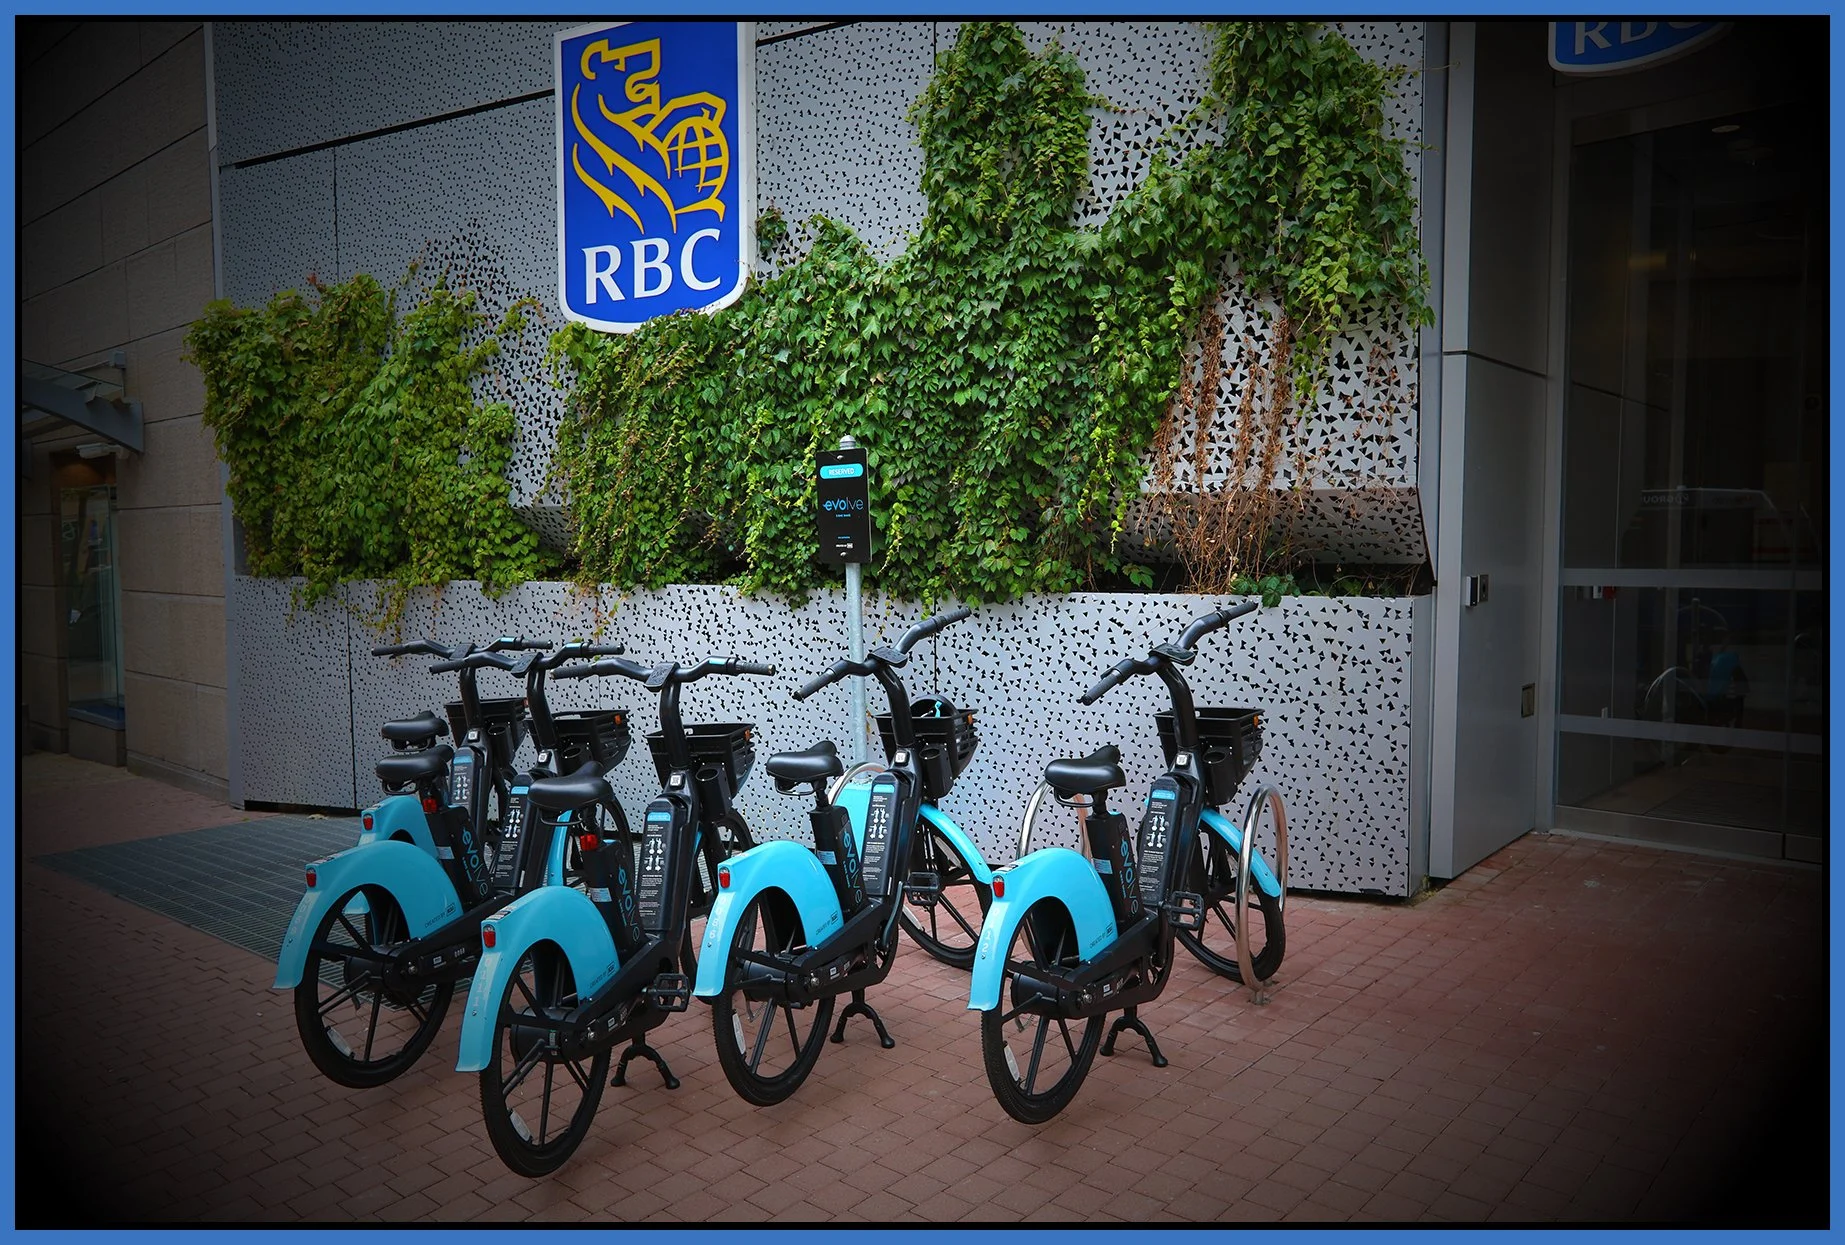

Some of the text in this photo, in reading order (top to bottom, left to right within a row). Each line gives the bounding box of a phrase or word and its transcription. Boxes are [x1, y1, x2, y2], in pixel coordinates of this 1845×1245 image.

[581, 228, 721, 305] RBC
[823, 497, 864, 511] evolve
[828, 467, 854, 476] RESERVED
[462, 828, 489, 896] evolve
[843, 830, 863, 904] evolve
[1120, 837, 1139, 915] evolve
[618, 865, 640, 942] evolve
